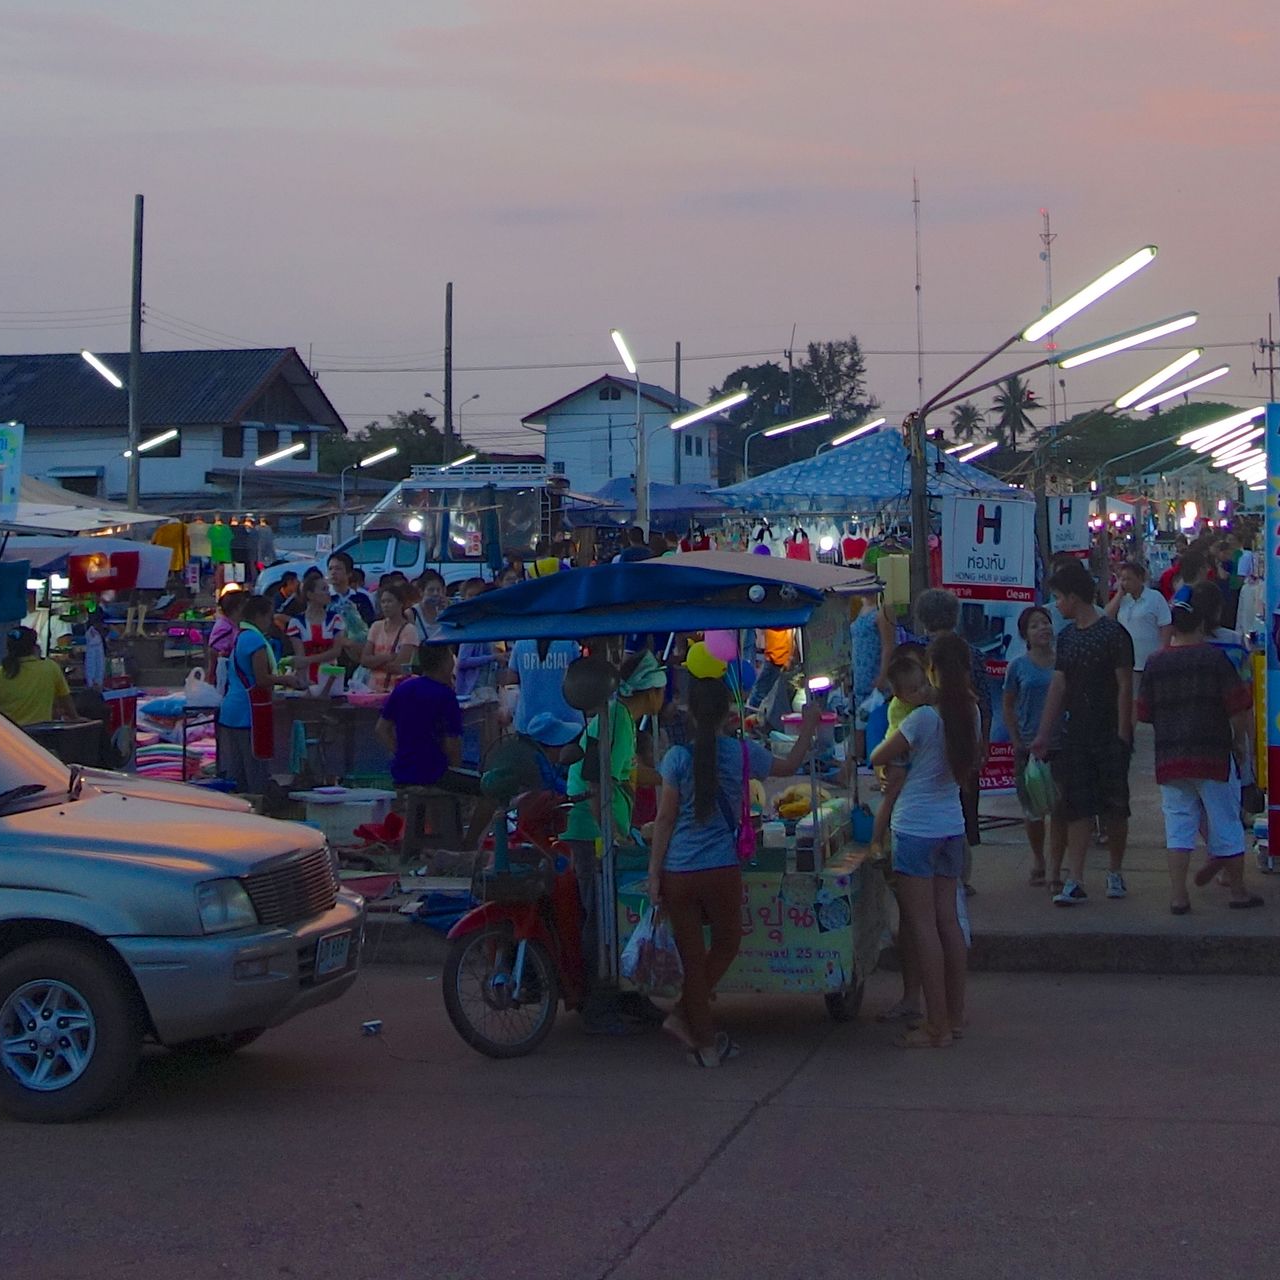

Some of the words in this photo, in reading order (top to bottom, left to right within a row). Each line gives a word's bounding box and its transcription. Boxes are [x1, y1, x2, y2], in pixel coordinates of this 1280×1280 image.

[976, 503, 1002, 545] H
[967, 547, 1006, 571] ห้องหับ
[1006, 588, 1031, 600] Clean
